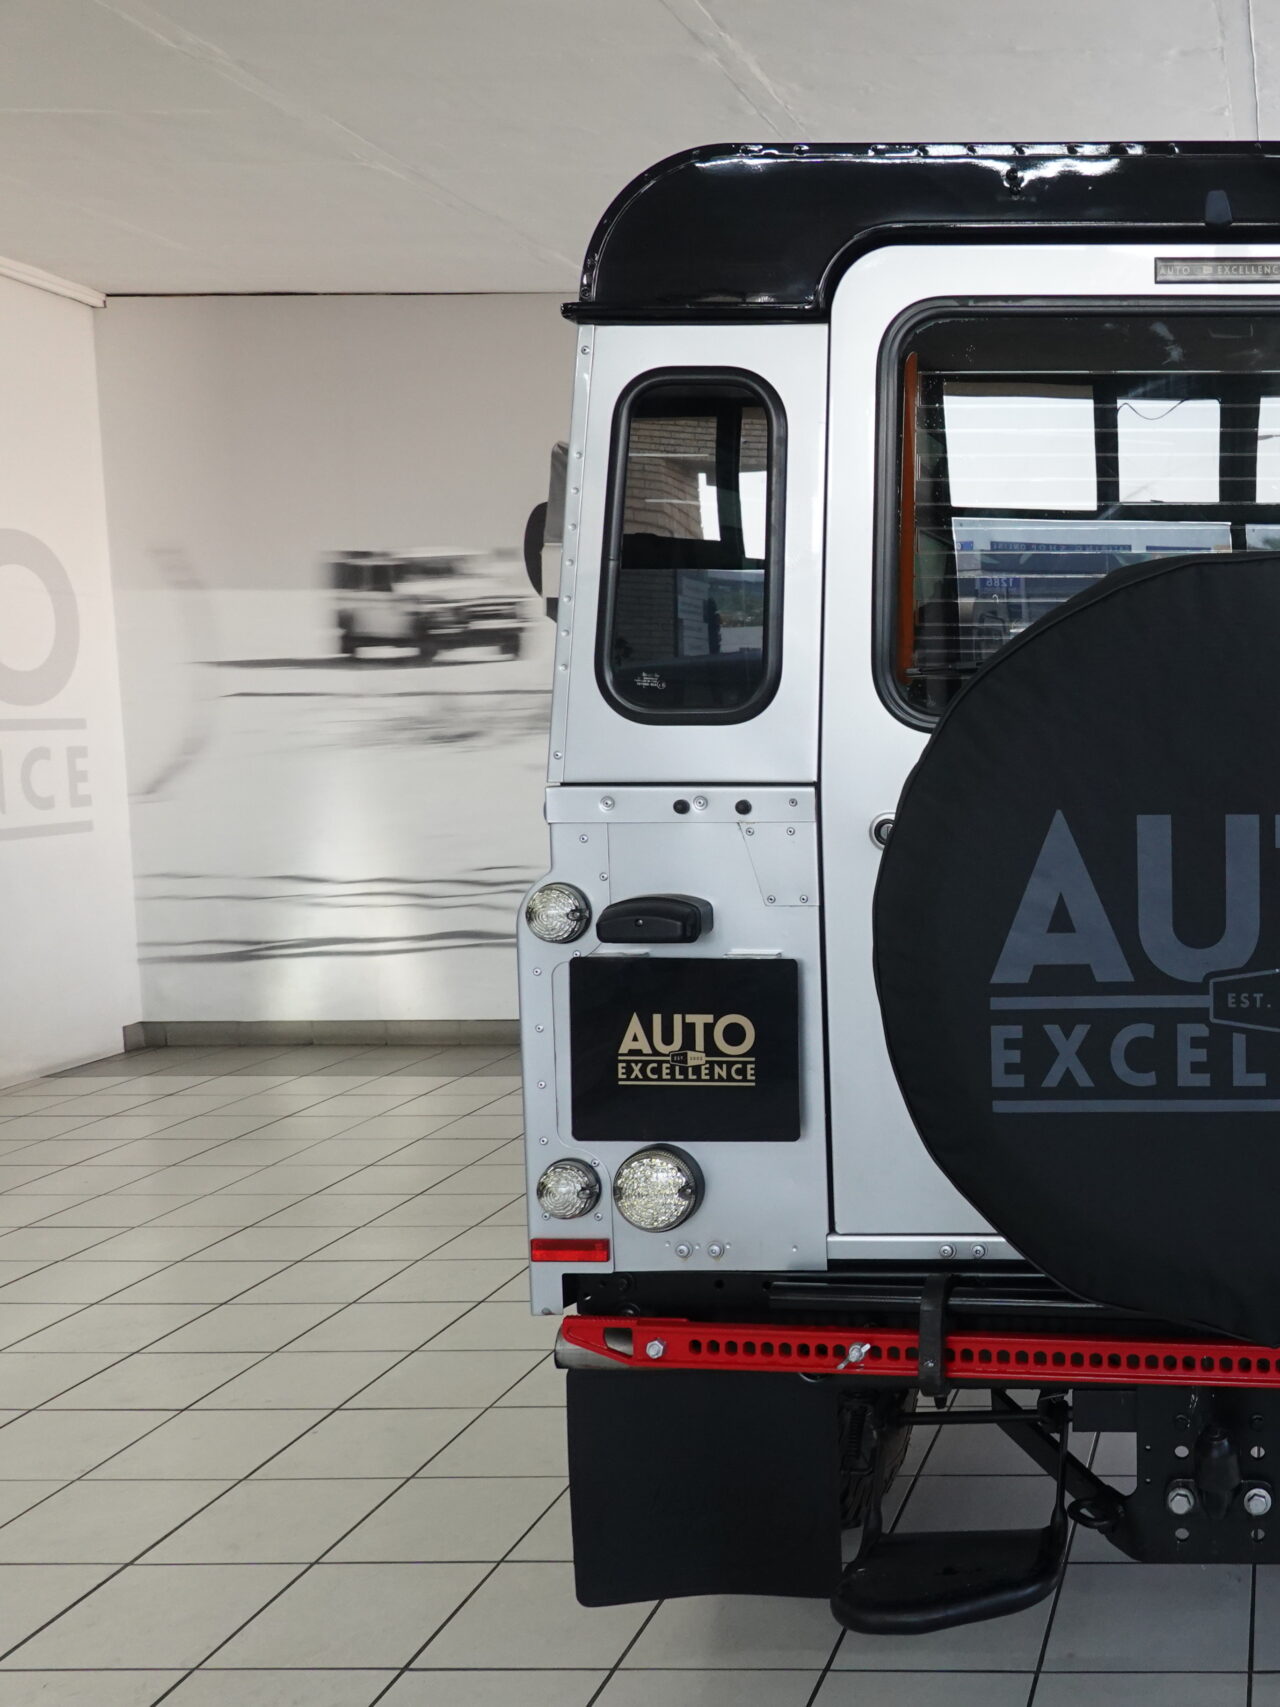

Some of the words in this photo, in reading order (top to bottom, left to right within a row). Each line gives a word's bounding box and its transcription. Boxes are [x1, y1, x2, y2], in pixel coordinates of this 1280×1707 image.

[1159, 266, 1191, 275] AUTO
[1227, 992, 1272, 1008] EST.
[617, 1011, 756, 1056] AUTO
[617, 1062, 756, 1080] EXCELLENCE
